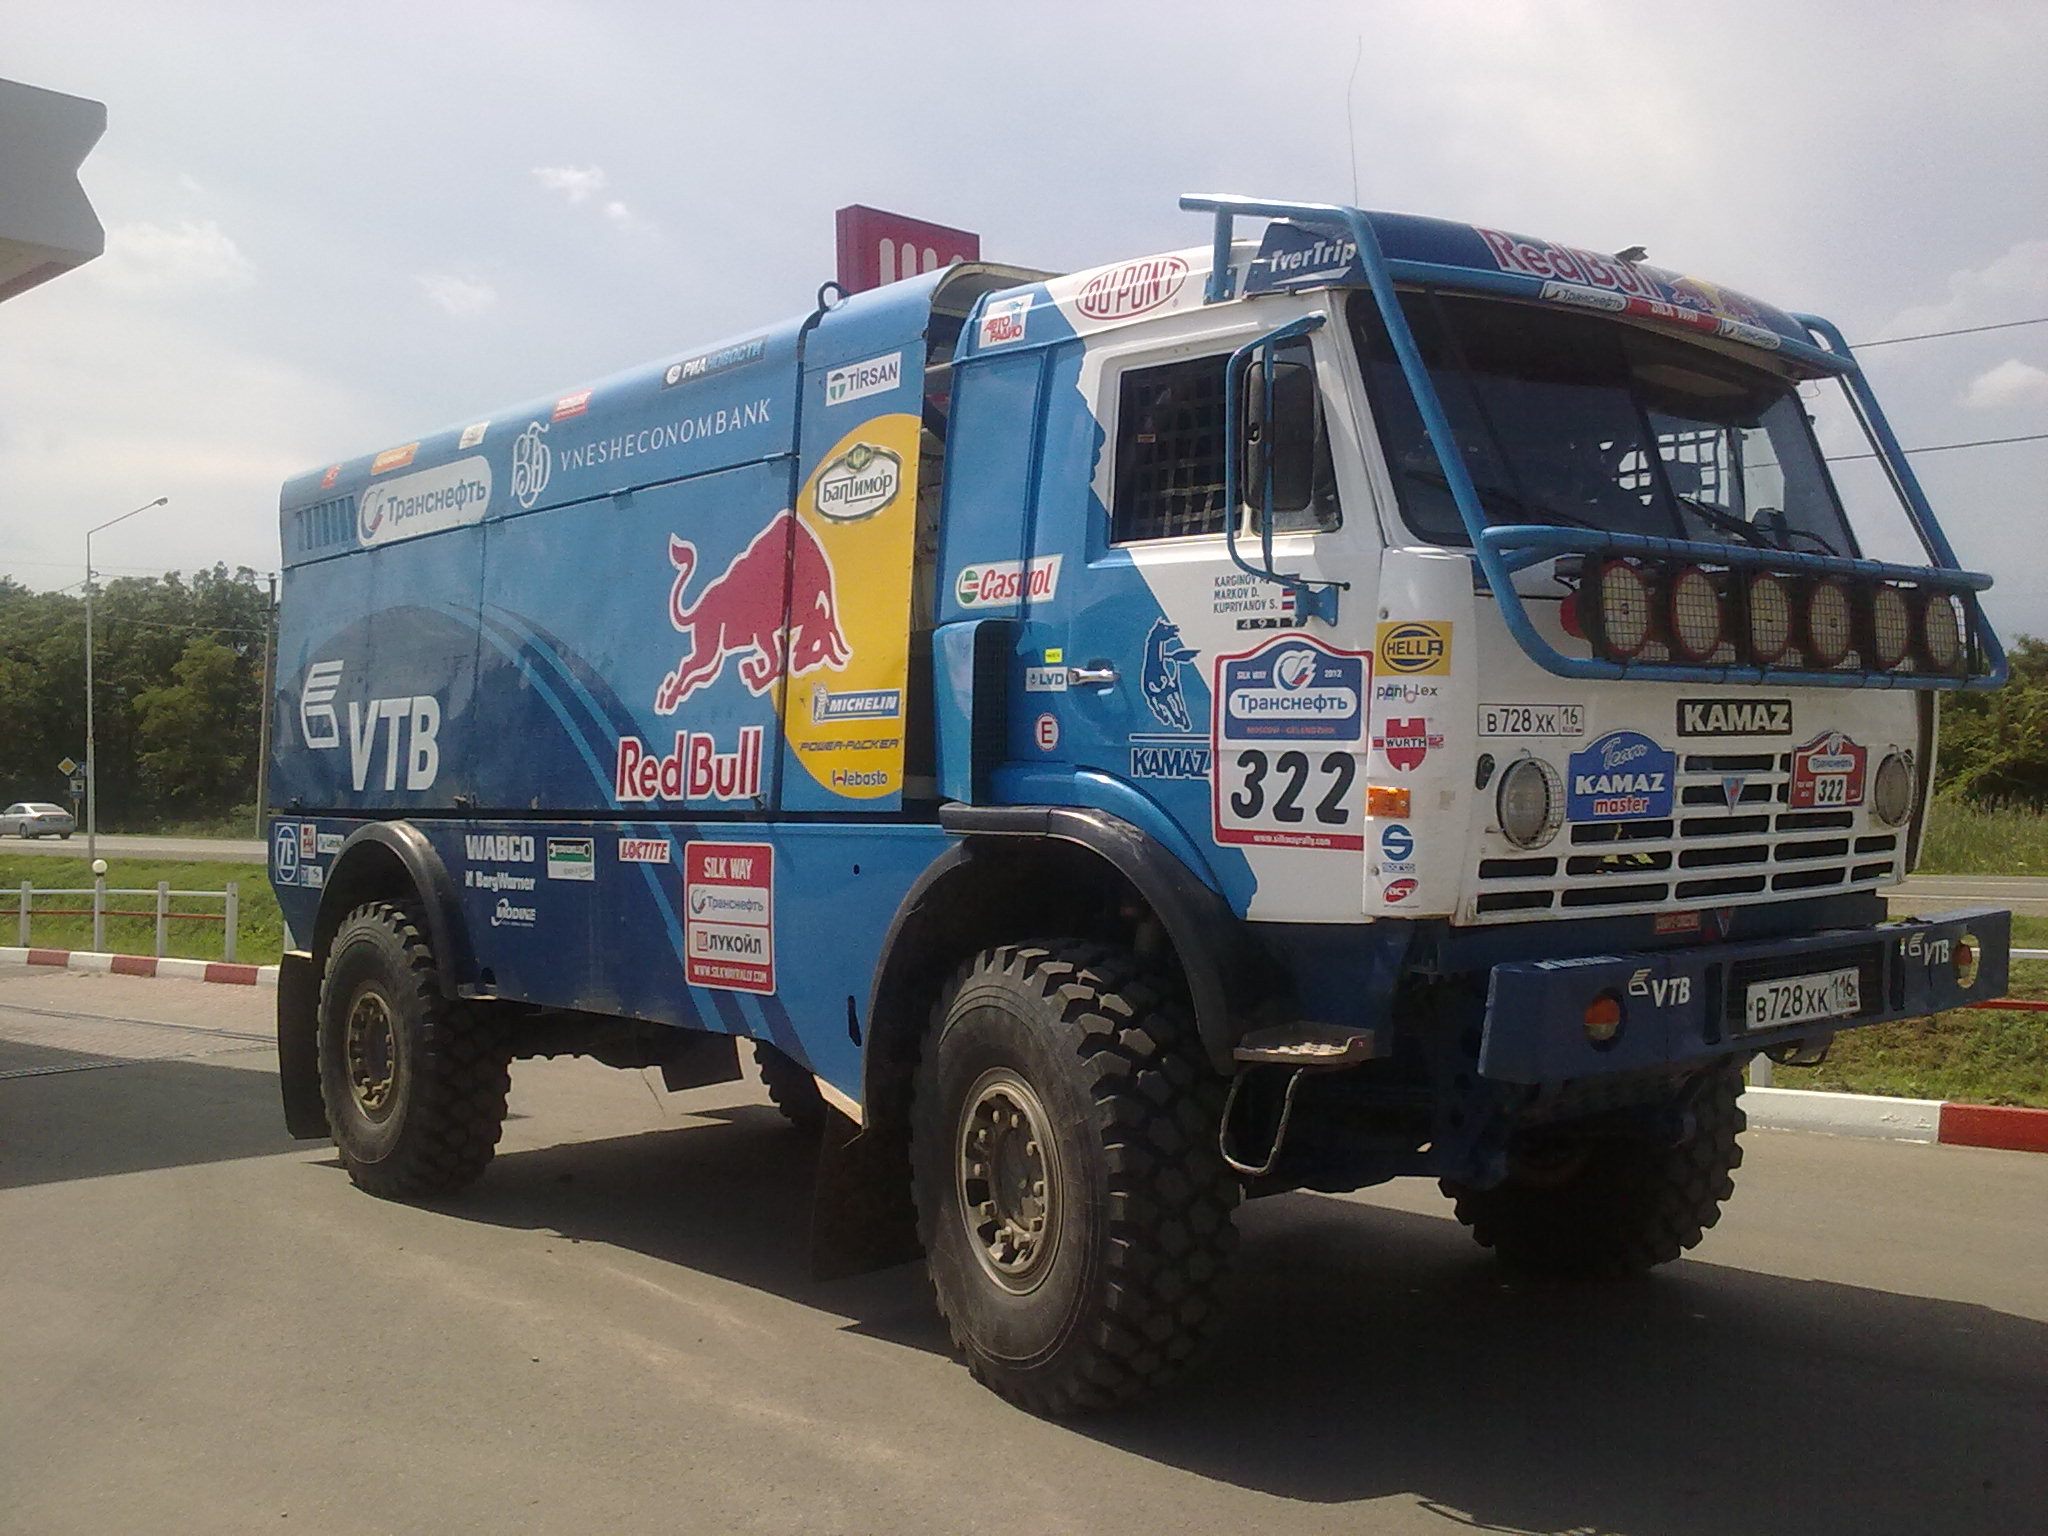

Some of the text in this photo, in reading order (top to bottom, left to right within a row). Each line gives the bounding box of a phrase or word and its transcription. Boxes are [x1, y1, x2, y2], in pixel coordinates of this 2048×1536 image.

[1270, 238, 1357, 273] TverTrip
[1476, 228, 1665, 301] Red Bull
[560, 398, 772, 472] VNESHECONOMBANK
[387, 478, 487, 525] Транснефть
[980, 563, 1054, 601] Castrol
[1213, 587, 1249, 600] MARKOV
[1213, 598, 1278, 613] KUPRIYANOV S.
[1386, 639, 1444, 656] HELLA
[1040, 673, 1064, 685] LVD
[829, 695, 898, 712] MICHELIN
[1238, 694, 1347, 713] Транснефть
[1684, 703, 1790, 732] KAMAZ
[348, 695, 441, 791] VTB
[1041, 721, 1054, 744] E
[616, 726, 764, 801] Red Bull
[1132, 747, 1212, 779] KAMAZ
[1601, 737, 1648, 770] Team
[1230, 749, 1356, 825] 322
[1575, 773, 1665, 795] KAMAZ
[1818, 779, 1844, 802] 322
[1594, 795, 1649, 815] master
[278, 838, 298, 870] ZF
[465, 834, 535, 863] WABCO
[620, 840, 669, 860] LOCTITE
[703, 857, 753, 880] SILK WAY
[475, 871, 536, 892] BorgWarner
[706, 895, 764, 912] Транснефть
[709, 932, 762, 955] ЛУКОЙЛ
[1923, 939, 1949, 966] VTB
[1652, 977, 1691, 1008] VTB
